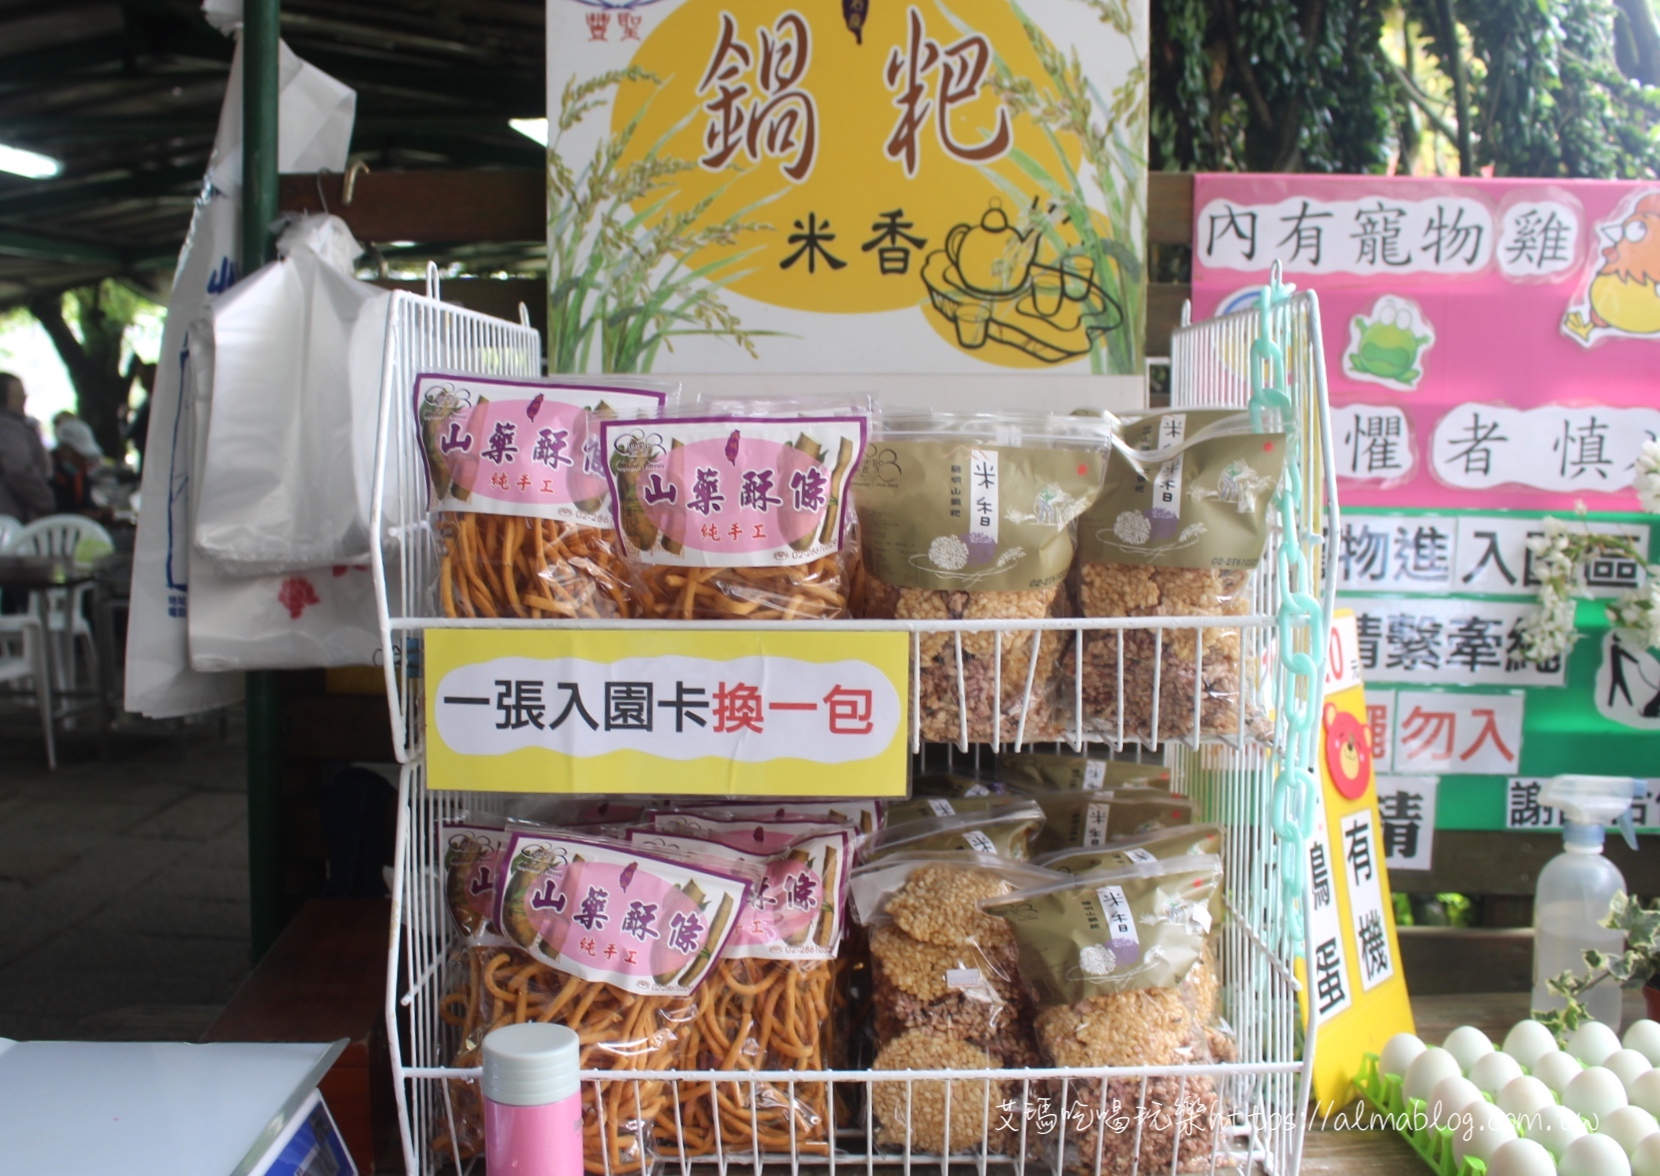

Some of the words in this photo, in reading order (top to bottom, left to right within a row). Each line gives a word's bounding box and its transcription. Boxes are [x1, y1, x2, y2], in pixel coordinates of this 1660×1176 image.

[699, 7, 1012, 181] 鍋粑
[778, 207, 928, 275] 米香
[489, 473, 556, 496] 純手工
[643, 466, 831, 517] 山藥酥條
[973, 460, 996, 527] 米香
[700, 523, 768, 542] 純手工
[1318, 524, 1641, 588] 物進入區
[443, 679, 875, 736] 一張入園卡換一包
[530, 879, 705, 955] 山藥酥條
[1102, 891, 1129, 932] 米香
[1344, 819, 1389, 981] 有機
[577, 936, 639, 965] 純手工
